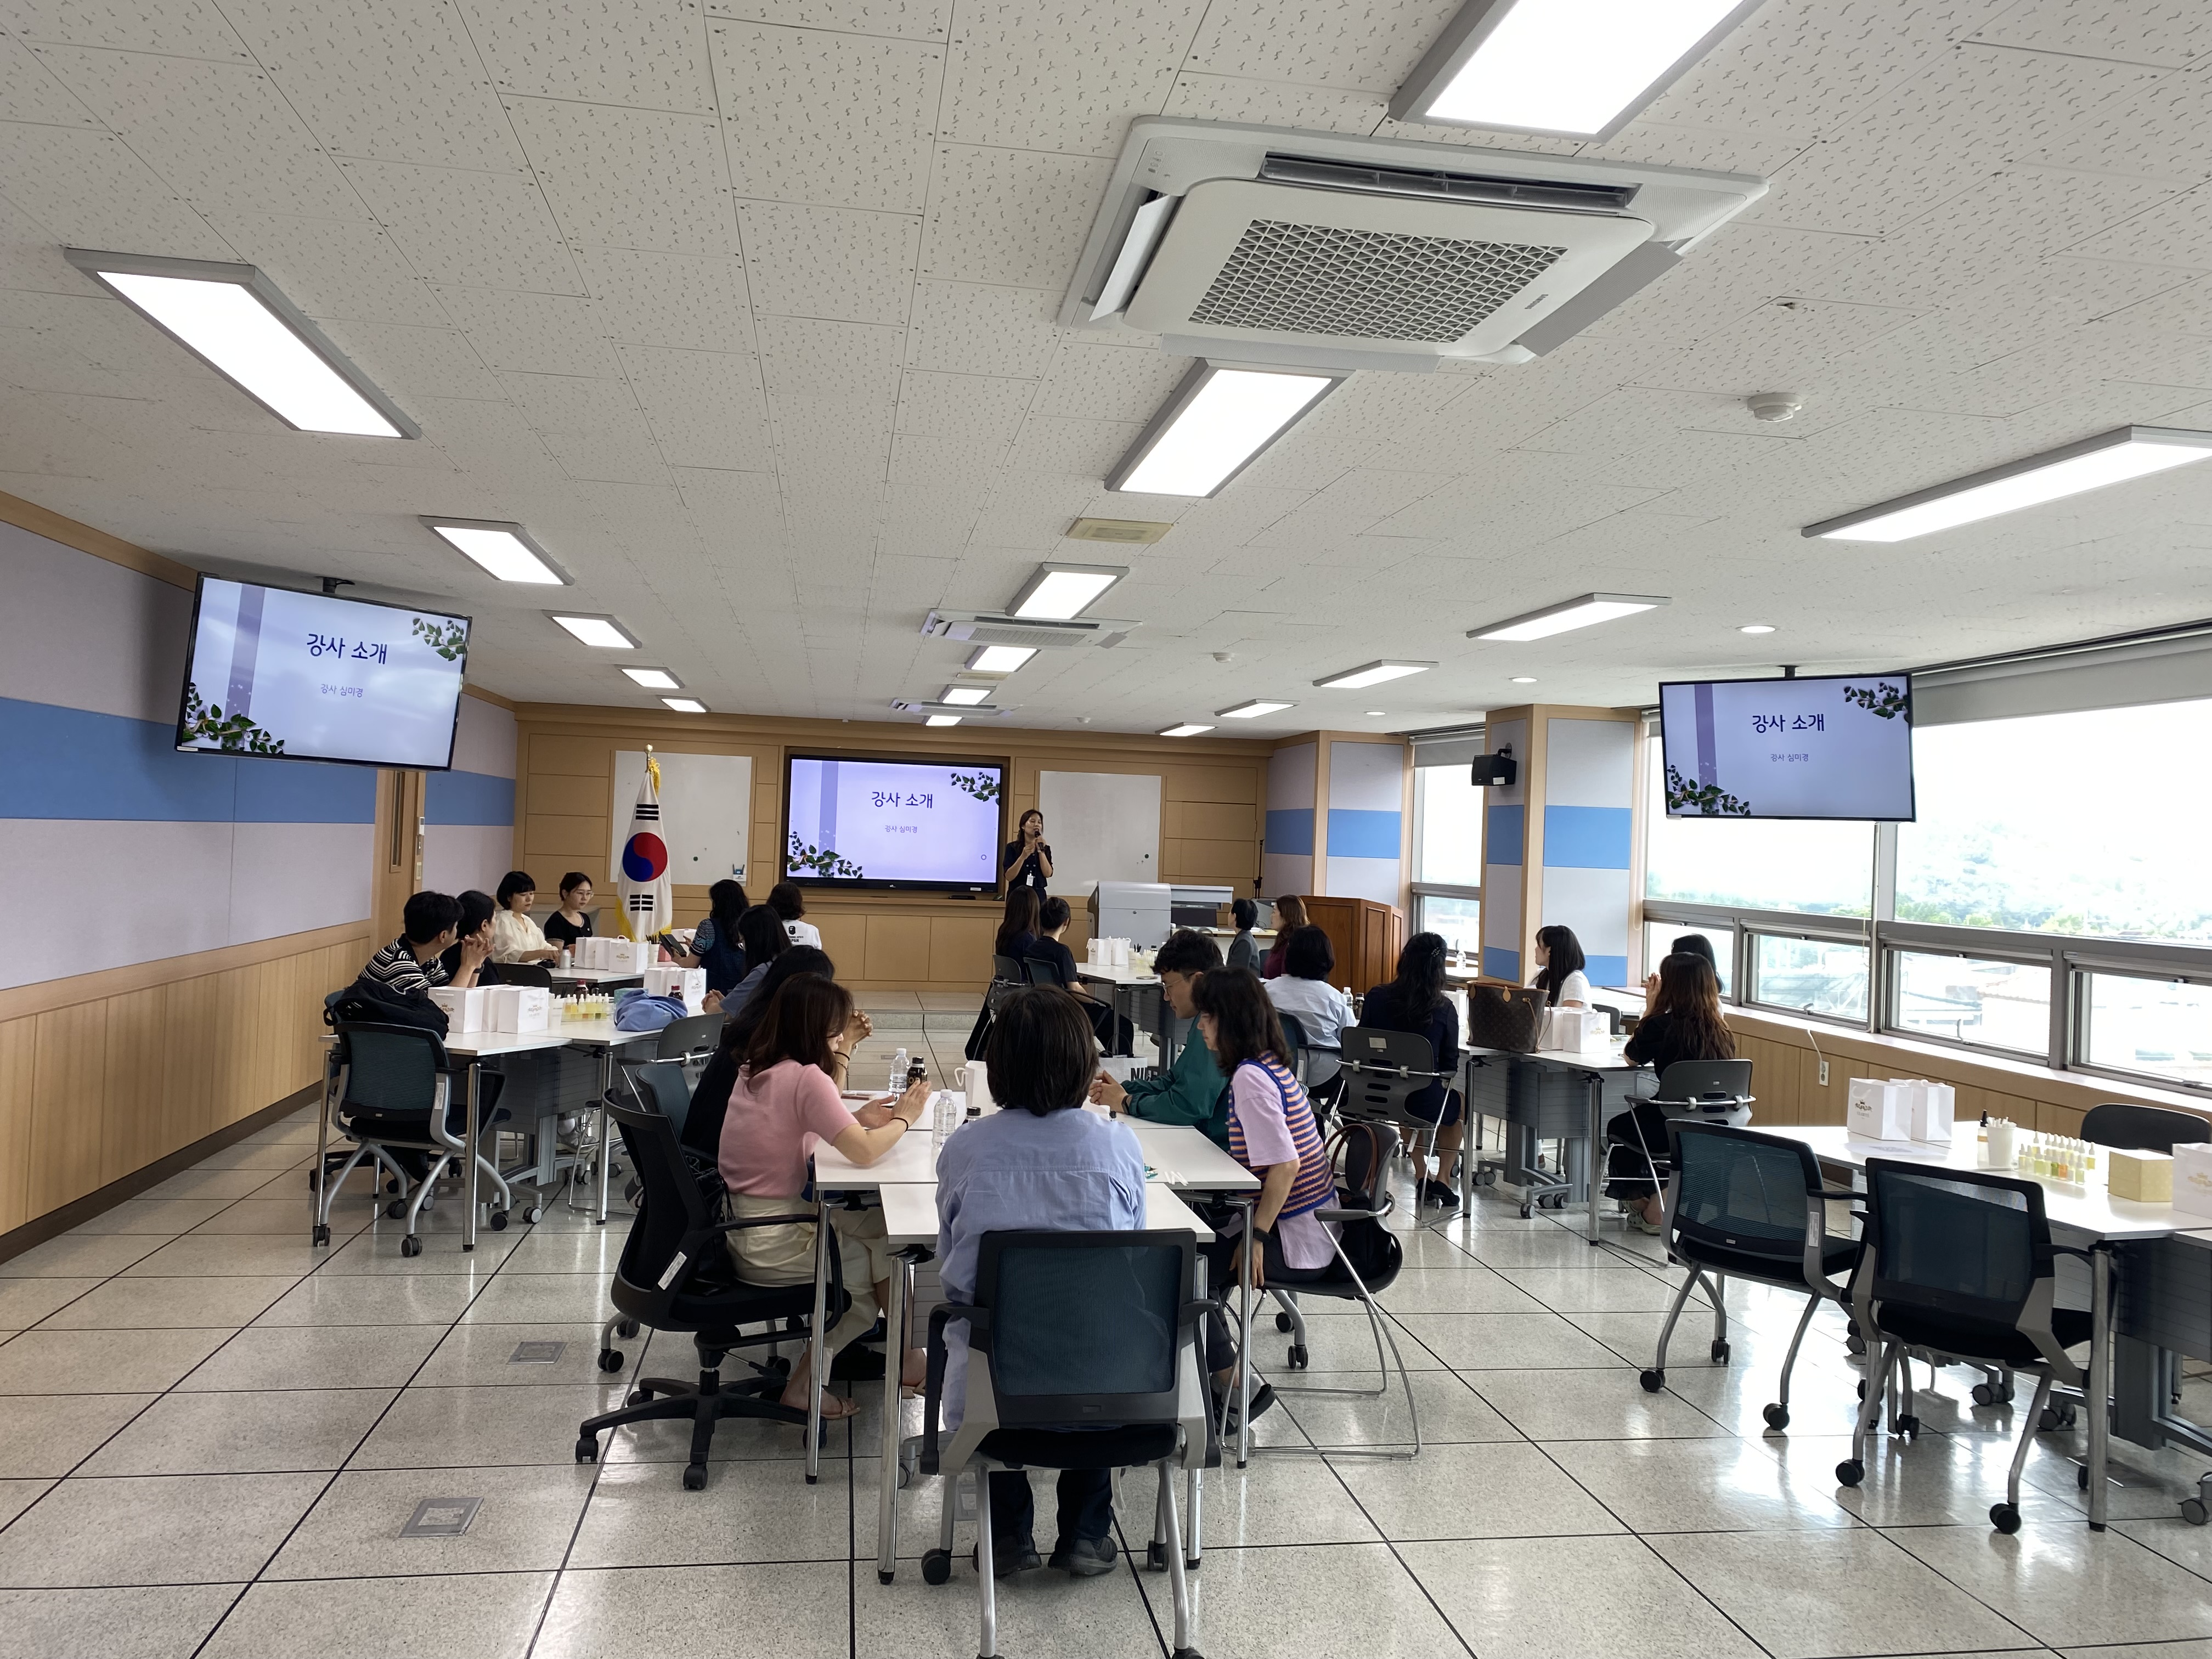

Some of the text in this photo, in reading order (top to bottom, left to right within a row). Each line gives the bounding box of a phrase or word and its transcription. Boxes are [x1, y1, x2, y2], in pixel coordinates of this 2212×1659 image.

[307, 633, 387, 665] 강사 소개
[320, 684, 363, 698] 강사 심미경
[1752, 713, 1825, 733] 강사 소개
[1770, 753, 1809, 762] 강사 심미경
[871, 791, 933, 809] 강사 소개
[885, 825, 918, 833] 강사 심미경
